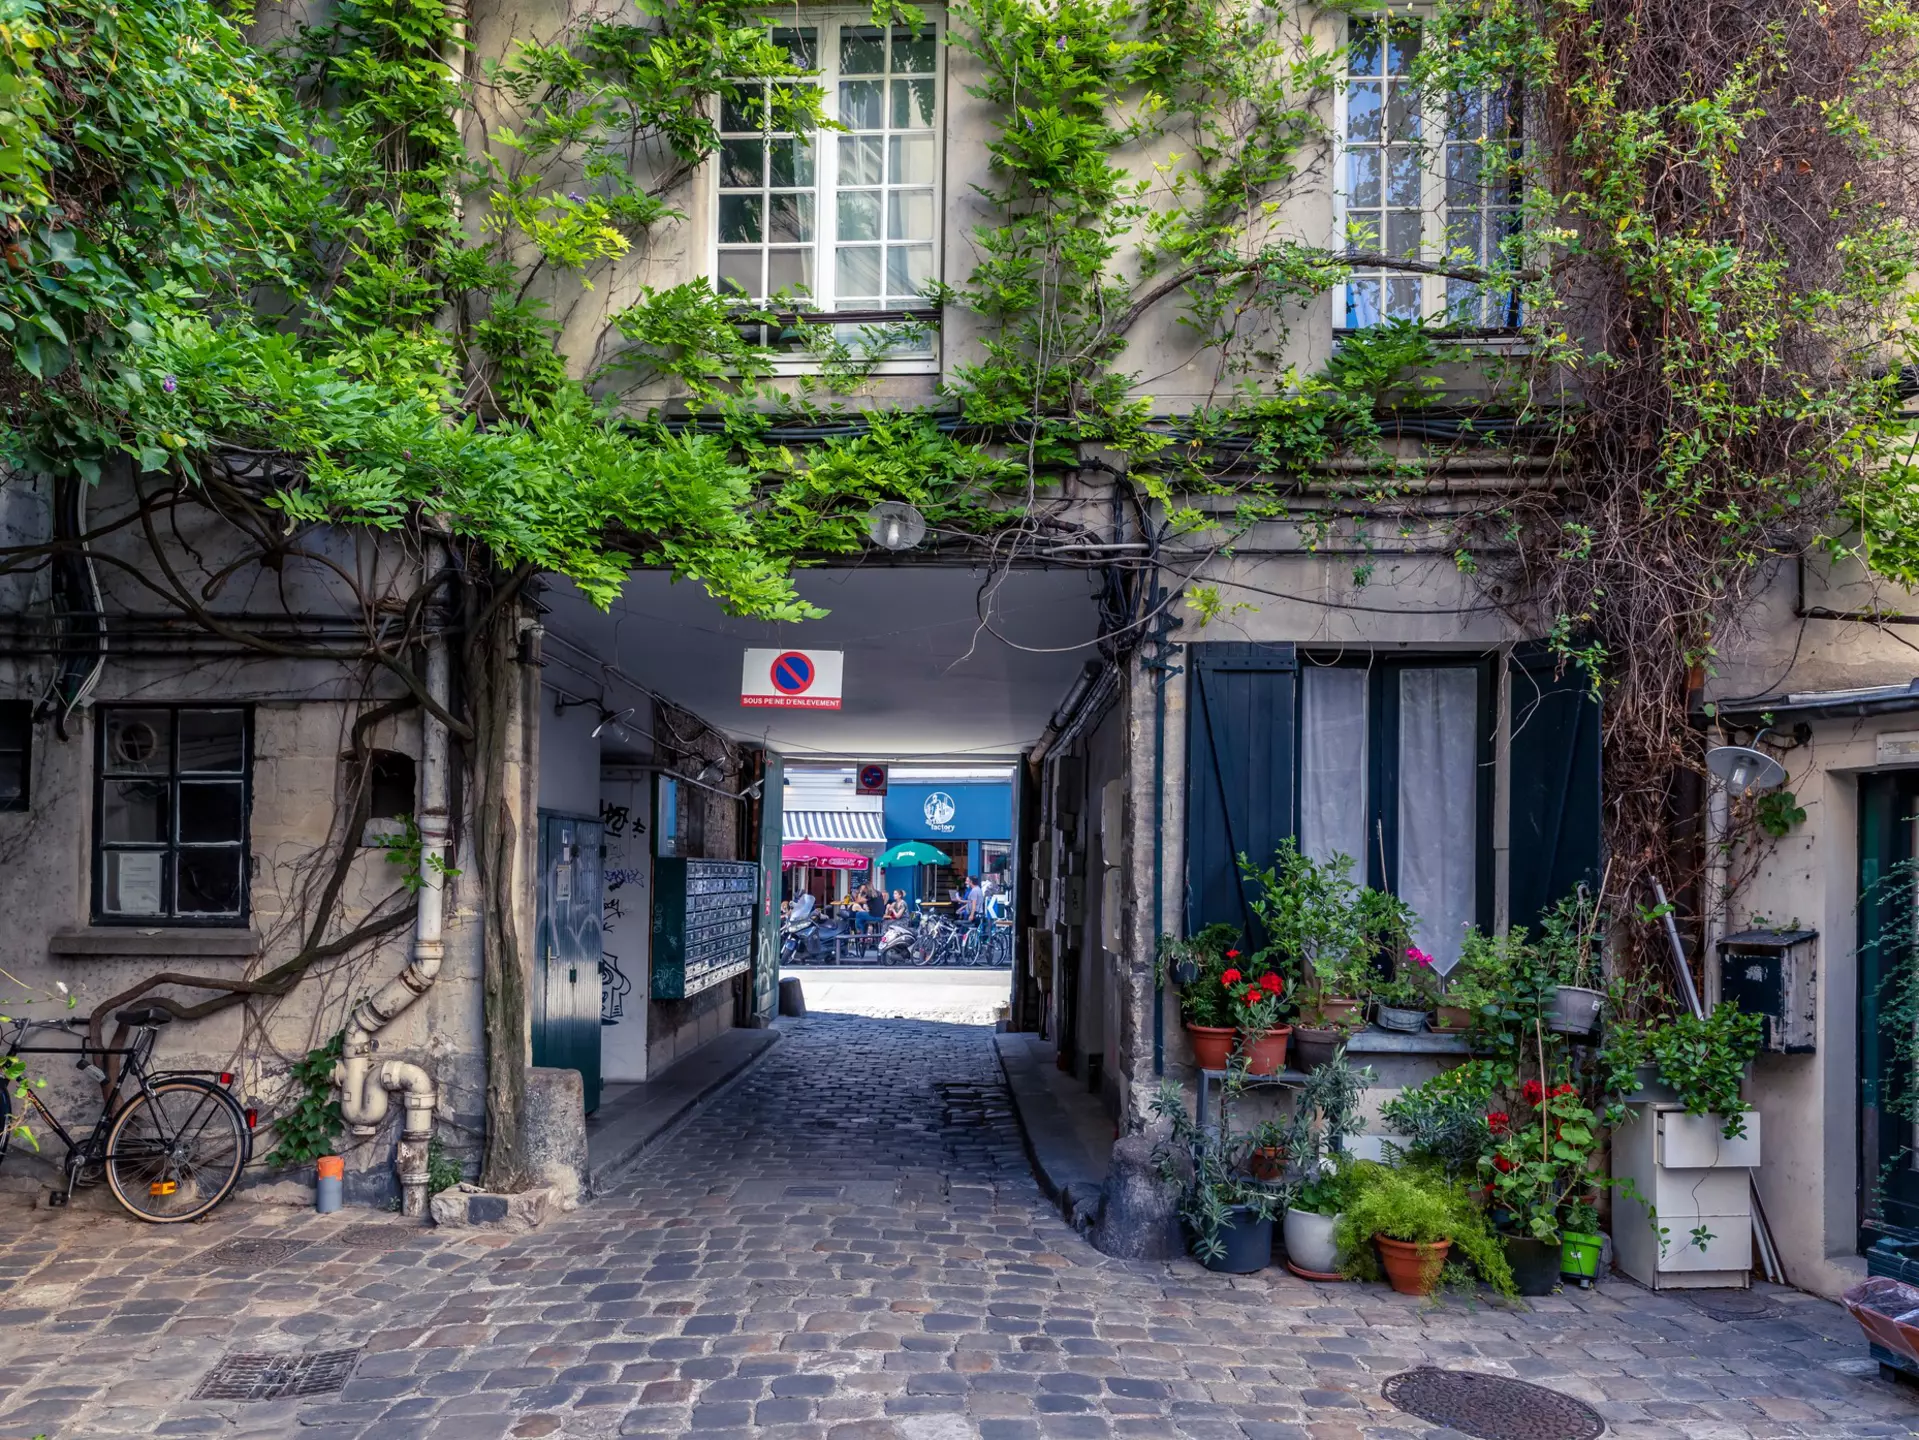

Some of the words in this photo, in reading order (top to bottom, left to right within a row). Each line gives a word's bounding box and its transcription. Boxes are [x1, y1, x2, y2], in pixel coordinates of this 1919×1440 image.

[743, 697, 762, 705] SOUS
[764, 697, 785, 705] PEINE
[786, 698, 840, 707] D'ENLEVEMENT
[931, 824, 955, 832] factory
